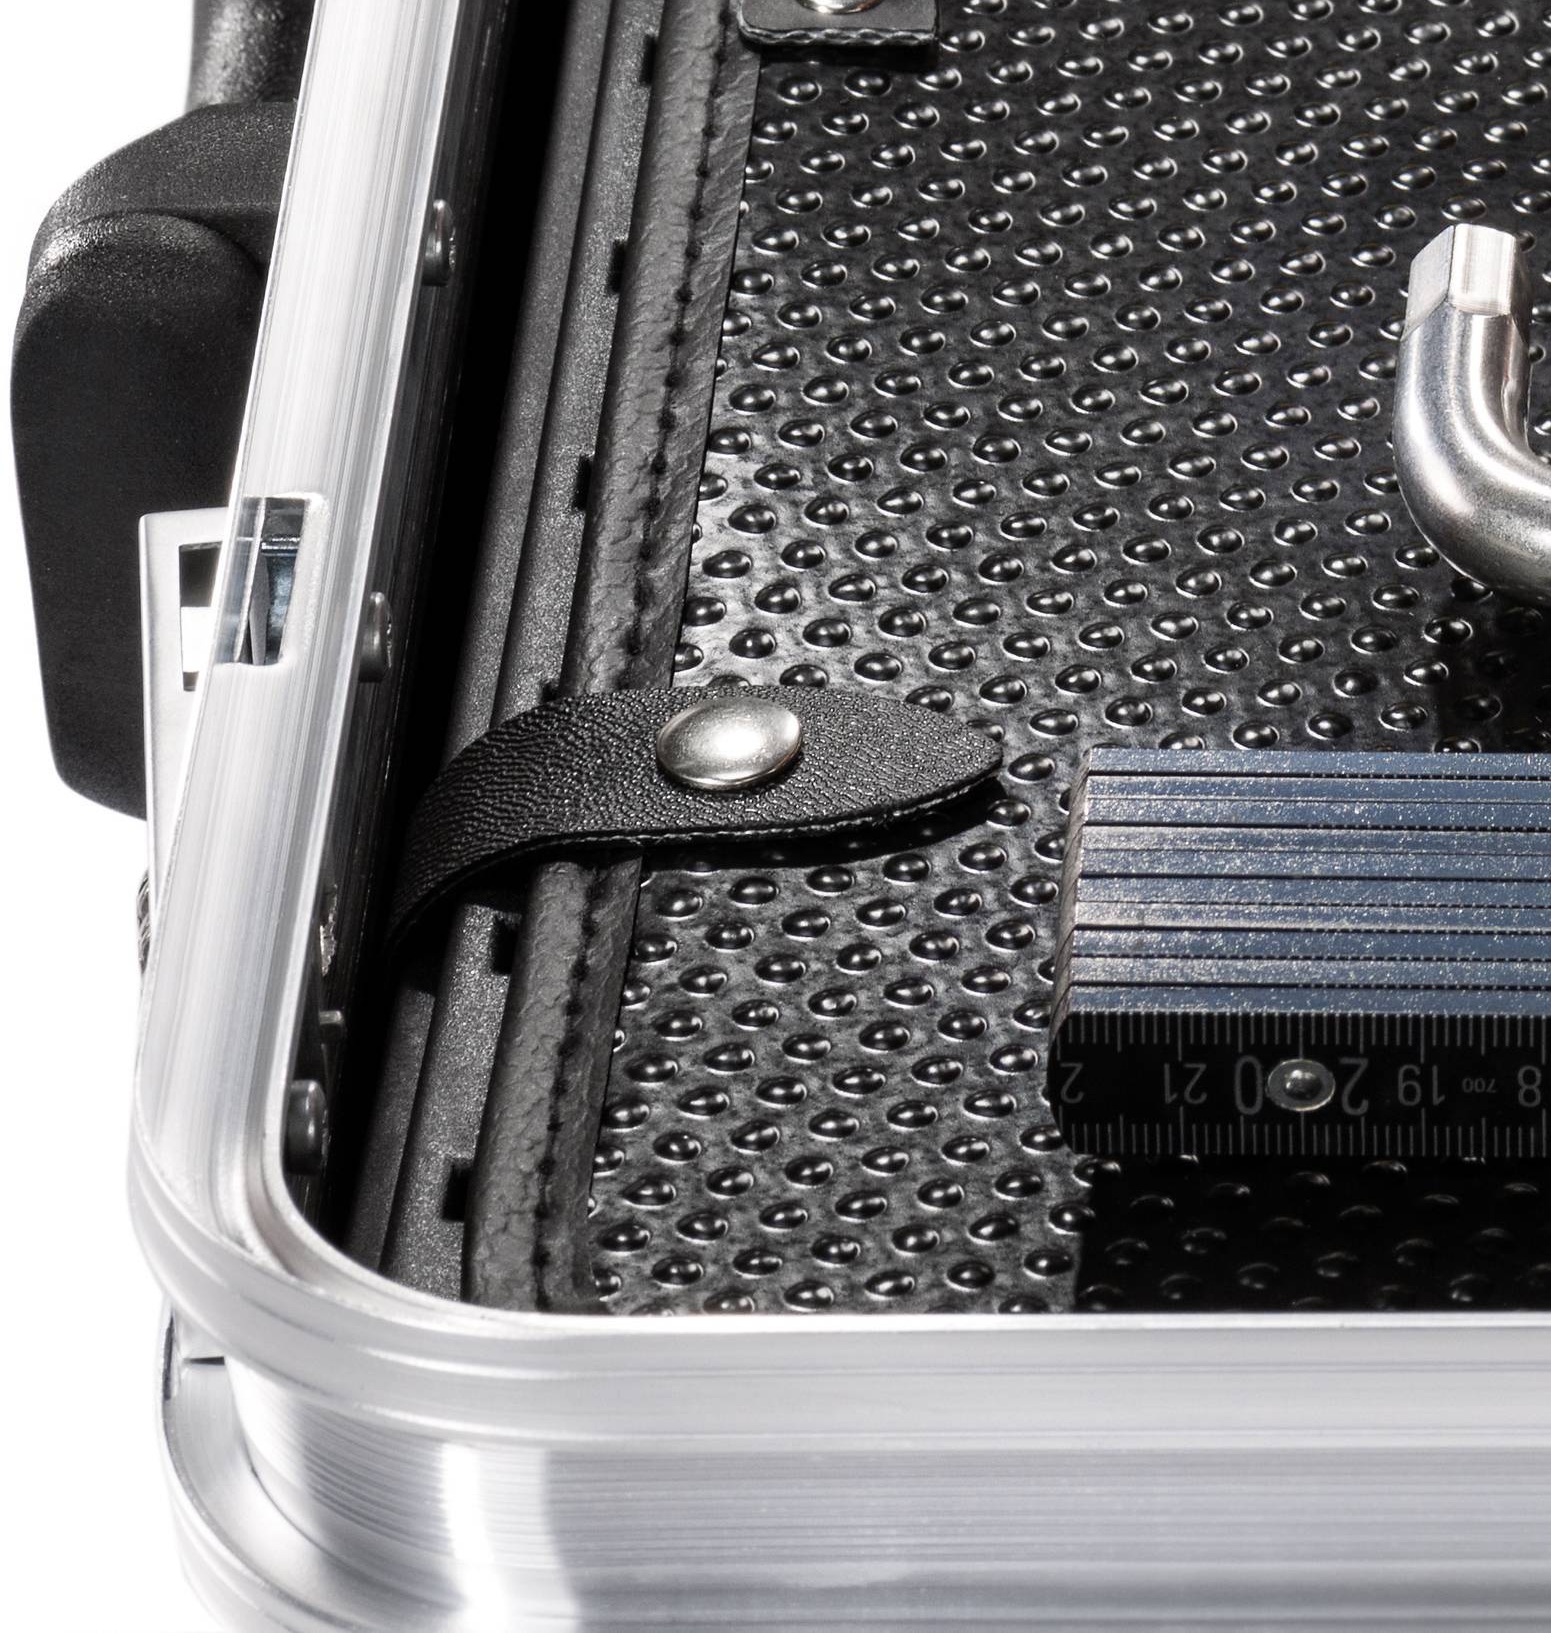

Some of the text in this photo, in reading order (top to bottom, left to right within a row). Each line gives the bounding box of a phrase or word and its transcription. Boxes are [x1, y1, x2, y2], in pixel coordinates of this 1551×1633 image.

[1164, 1063, 1207, 1104] 21
[1398, 1064, 1445, 1105] 19
[1460, 1077, 1497, 1094] 700
